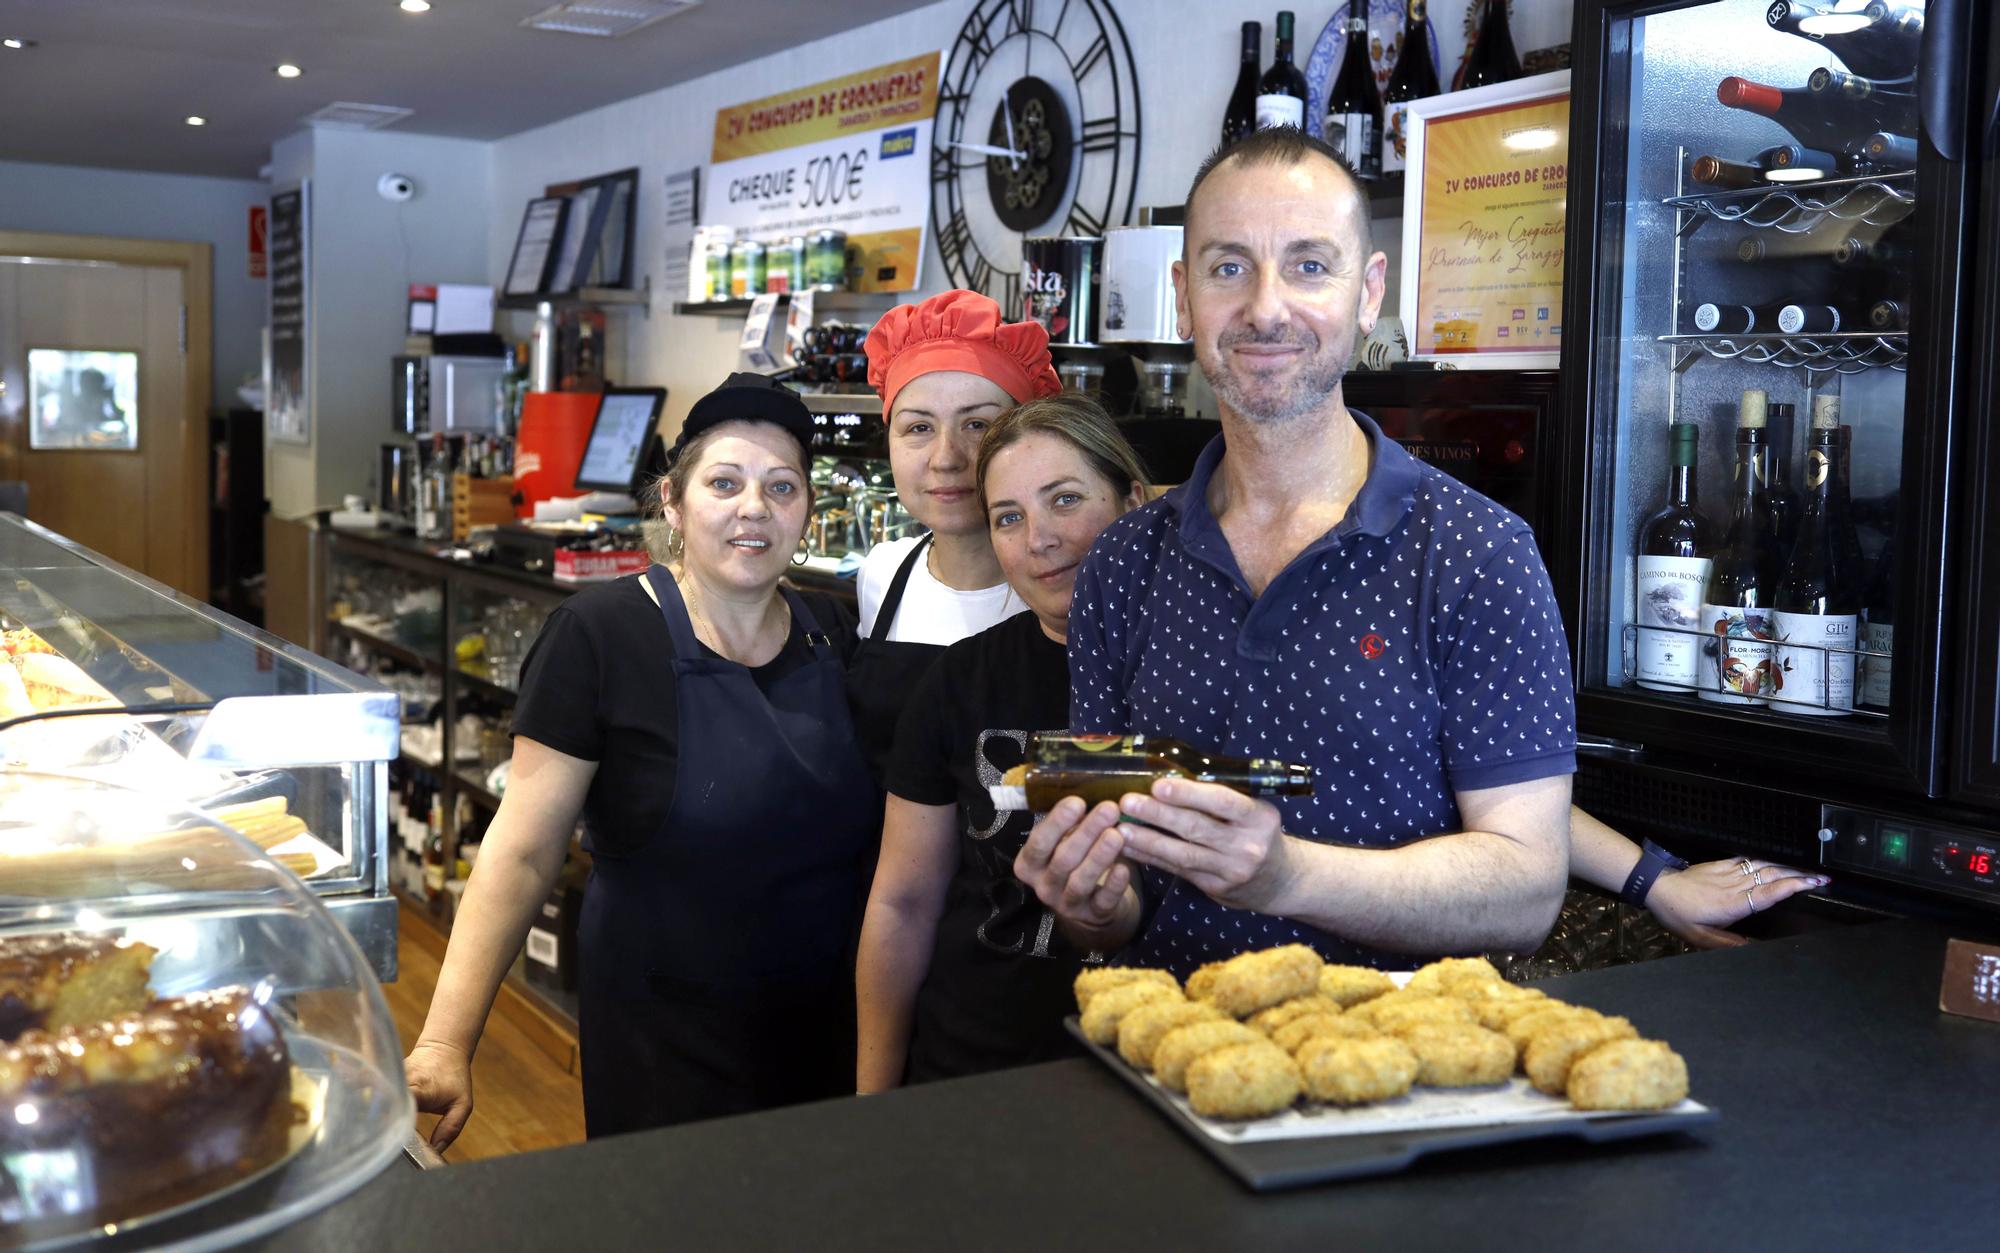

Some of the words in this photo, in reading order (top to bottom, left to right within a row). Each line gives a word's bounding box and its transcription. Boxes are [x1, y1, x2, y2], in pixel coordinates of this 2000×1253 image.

[748, 101, 815, 132] CONCURSO
[818, 90, 837, 117] DE
[839, 69, 926, 111] CROQUETAS
[728, 168, 797, 203] CHEQUE
[799, 148, 869, 209] 500€
[1446, 179, 1460, 194] IV
[1464, 170, 1520, 192] CONCURSO
[1524, 167, 1539, 184] DE
[1434, 446, 1472, 461] VINOS
[1969, 854, 1990, 874] 16
